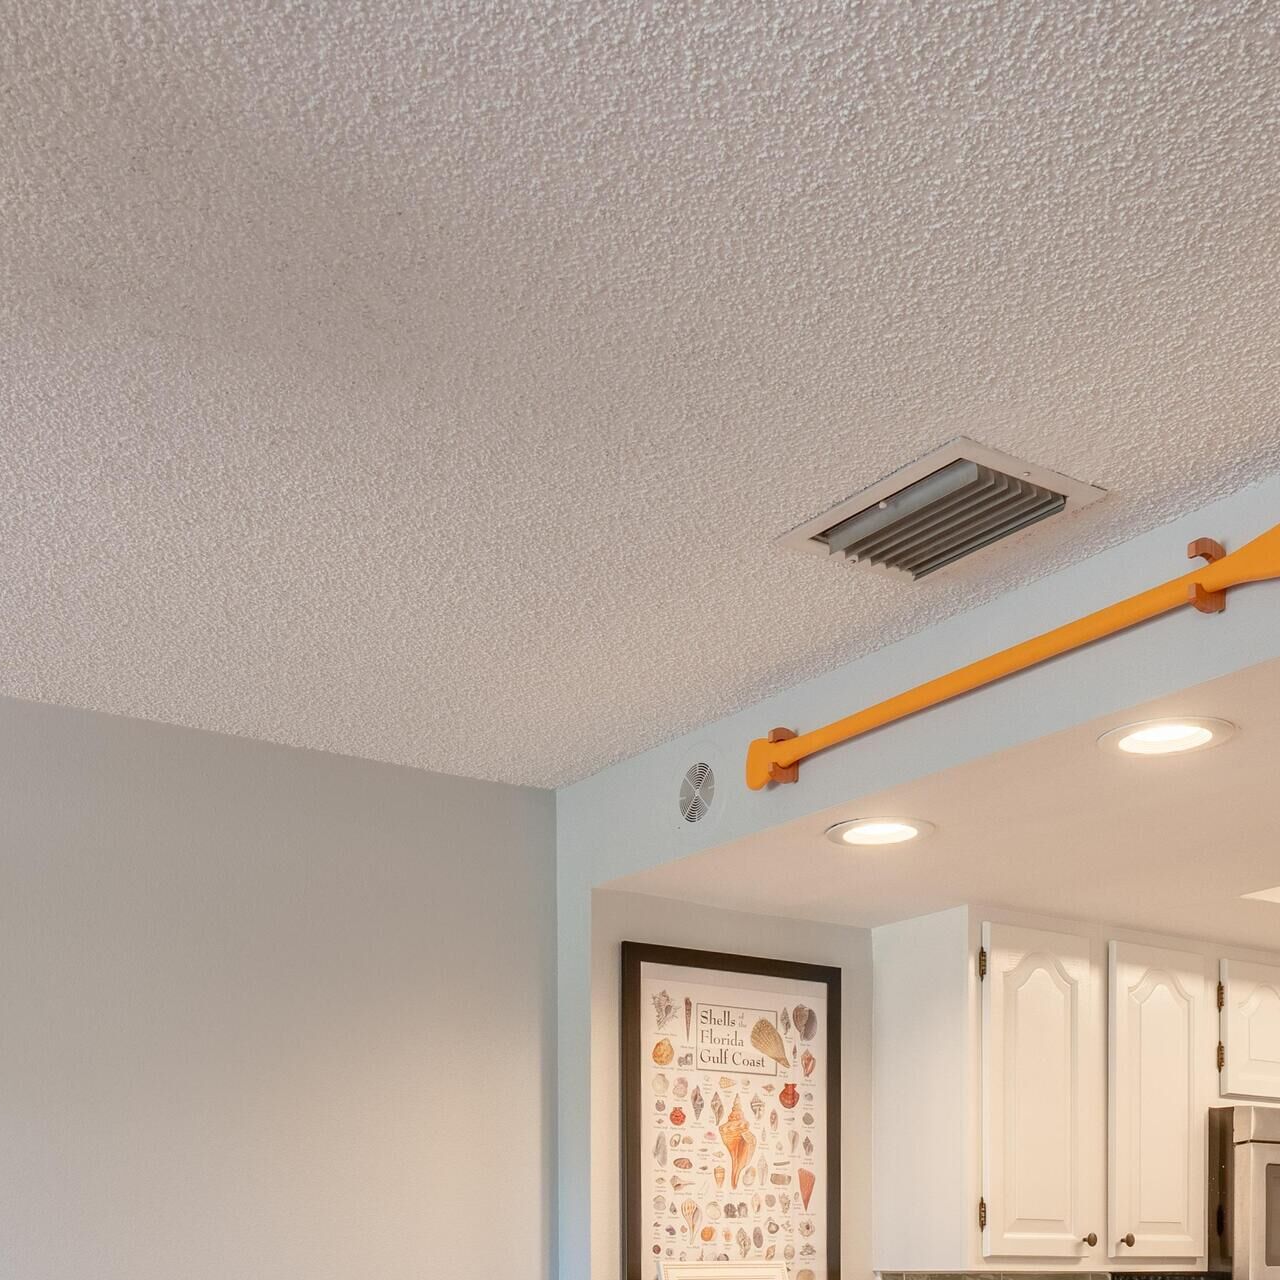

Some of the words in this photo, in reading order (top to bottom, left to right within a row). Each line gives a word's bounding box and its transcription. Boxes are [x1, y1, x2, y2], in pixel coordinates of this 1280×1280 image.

[700, 1009, 736, 1027] Shells
[700, 1028, 744, 1047] Florida
[700, 1048, 729, 1065] Gulf
[732, 1051, 765, 1068] Coast
